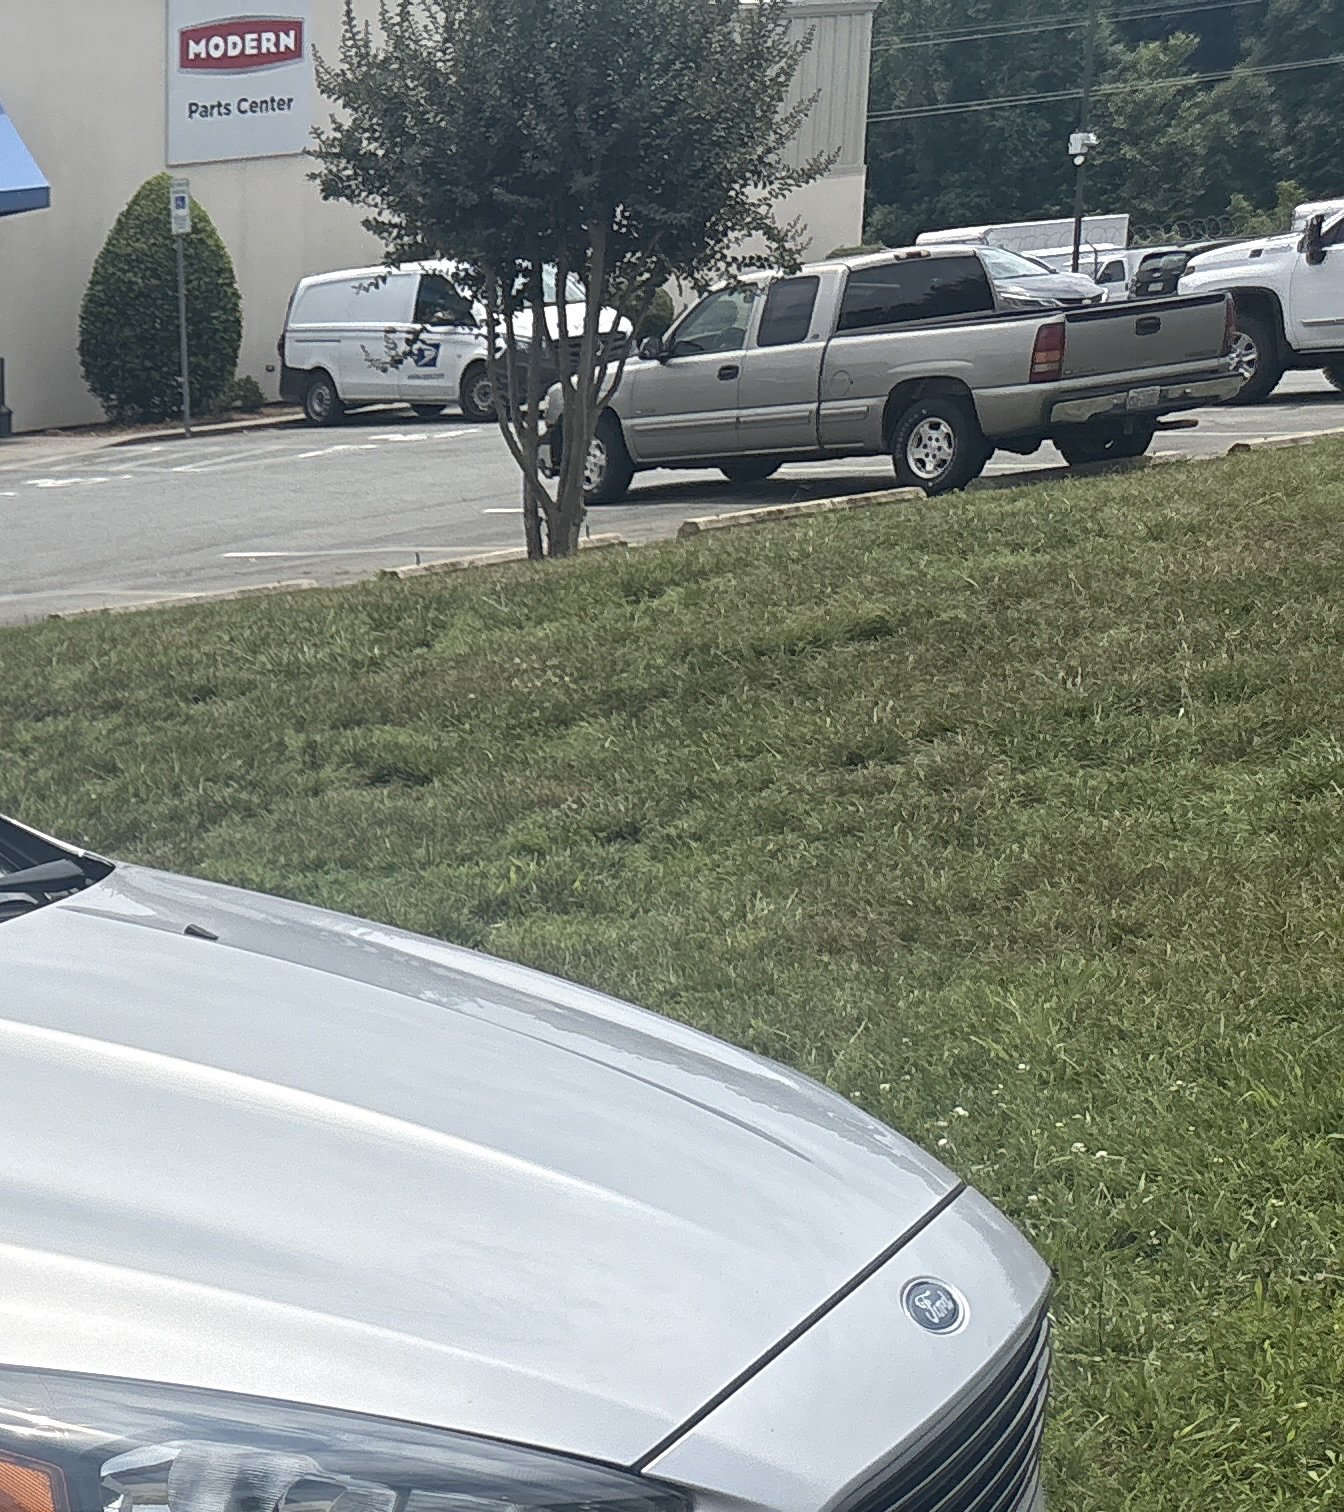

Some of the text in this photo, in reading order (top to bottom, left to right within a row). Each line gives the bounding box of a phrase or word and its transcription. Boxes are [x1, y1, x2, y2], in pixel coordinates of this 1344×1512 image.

[187, 29, 296, 60] MODERN
[187, 96, 294, 119] Parts Center
